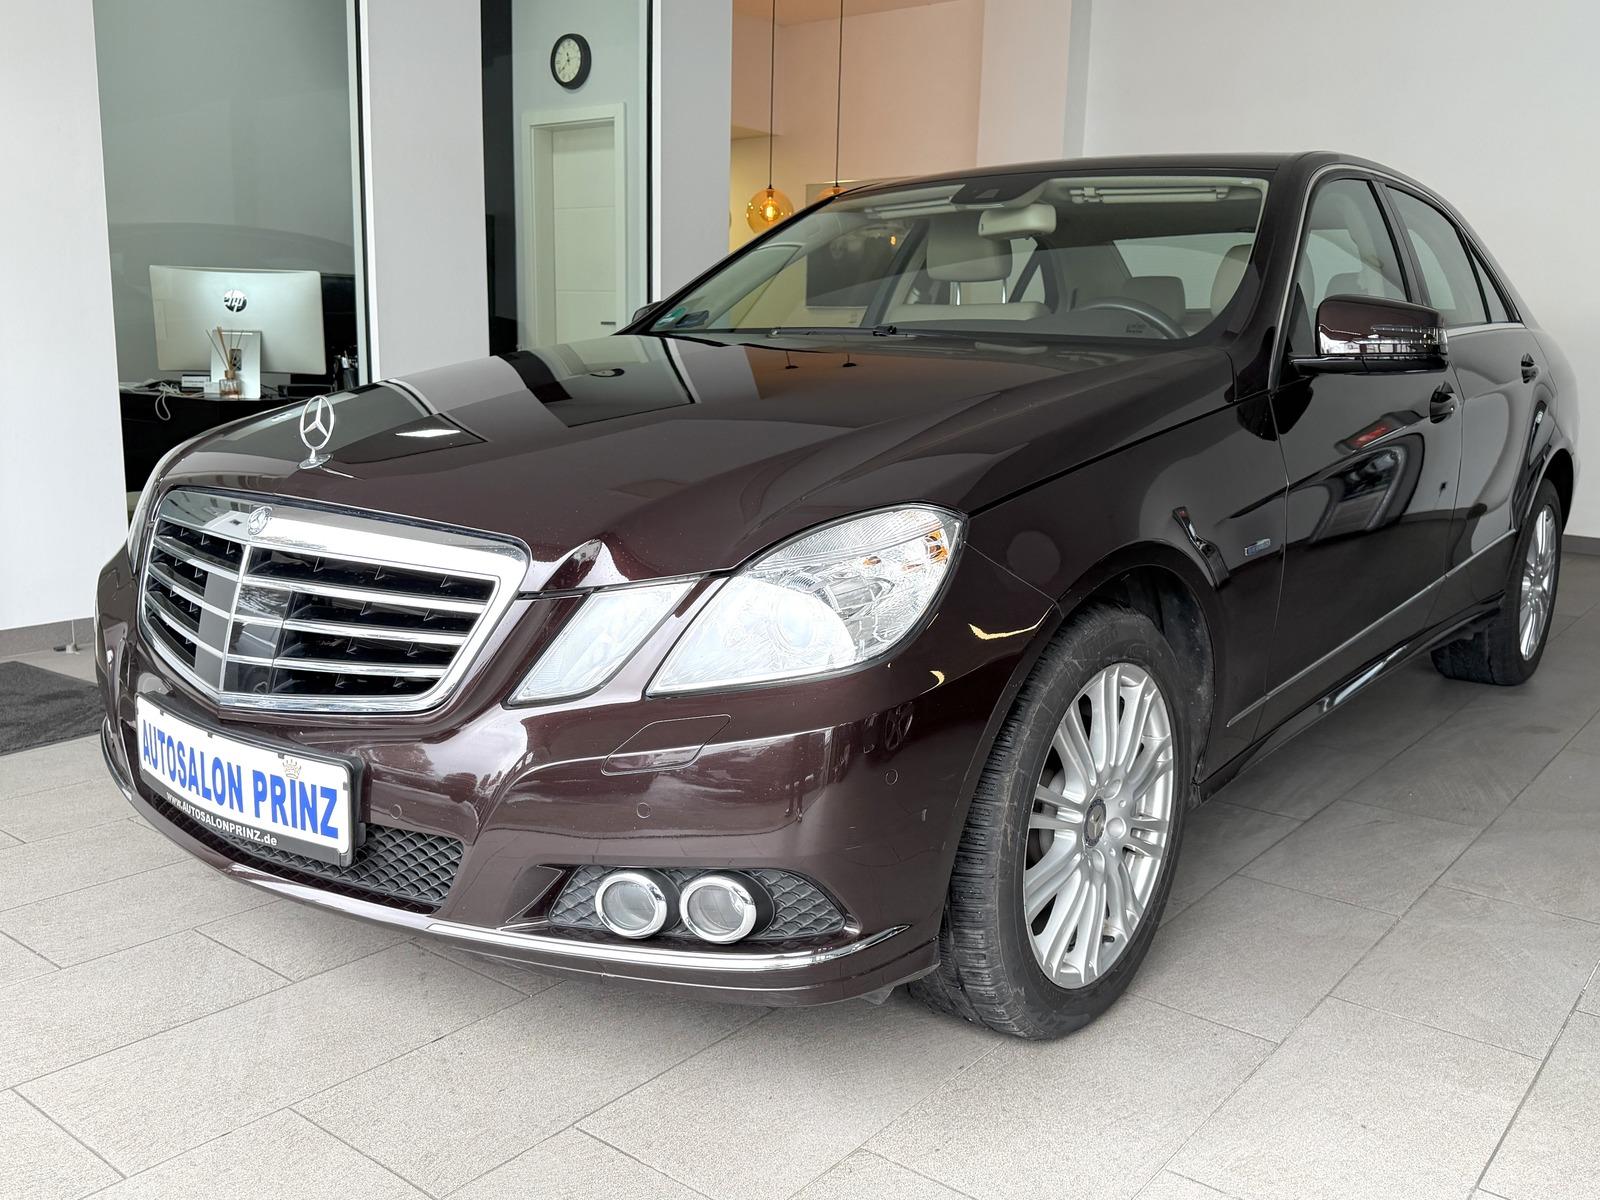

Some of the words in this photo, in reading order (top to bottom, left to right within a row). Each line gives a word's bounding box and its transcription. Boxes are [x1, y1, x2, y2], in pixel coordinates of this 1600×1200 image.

[226, 289, 246, 312] hp
[143, 719, 243, 813] AUTOSALON
[252, 769, 338, 839] PRINZ
